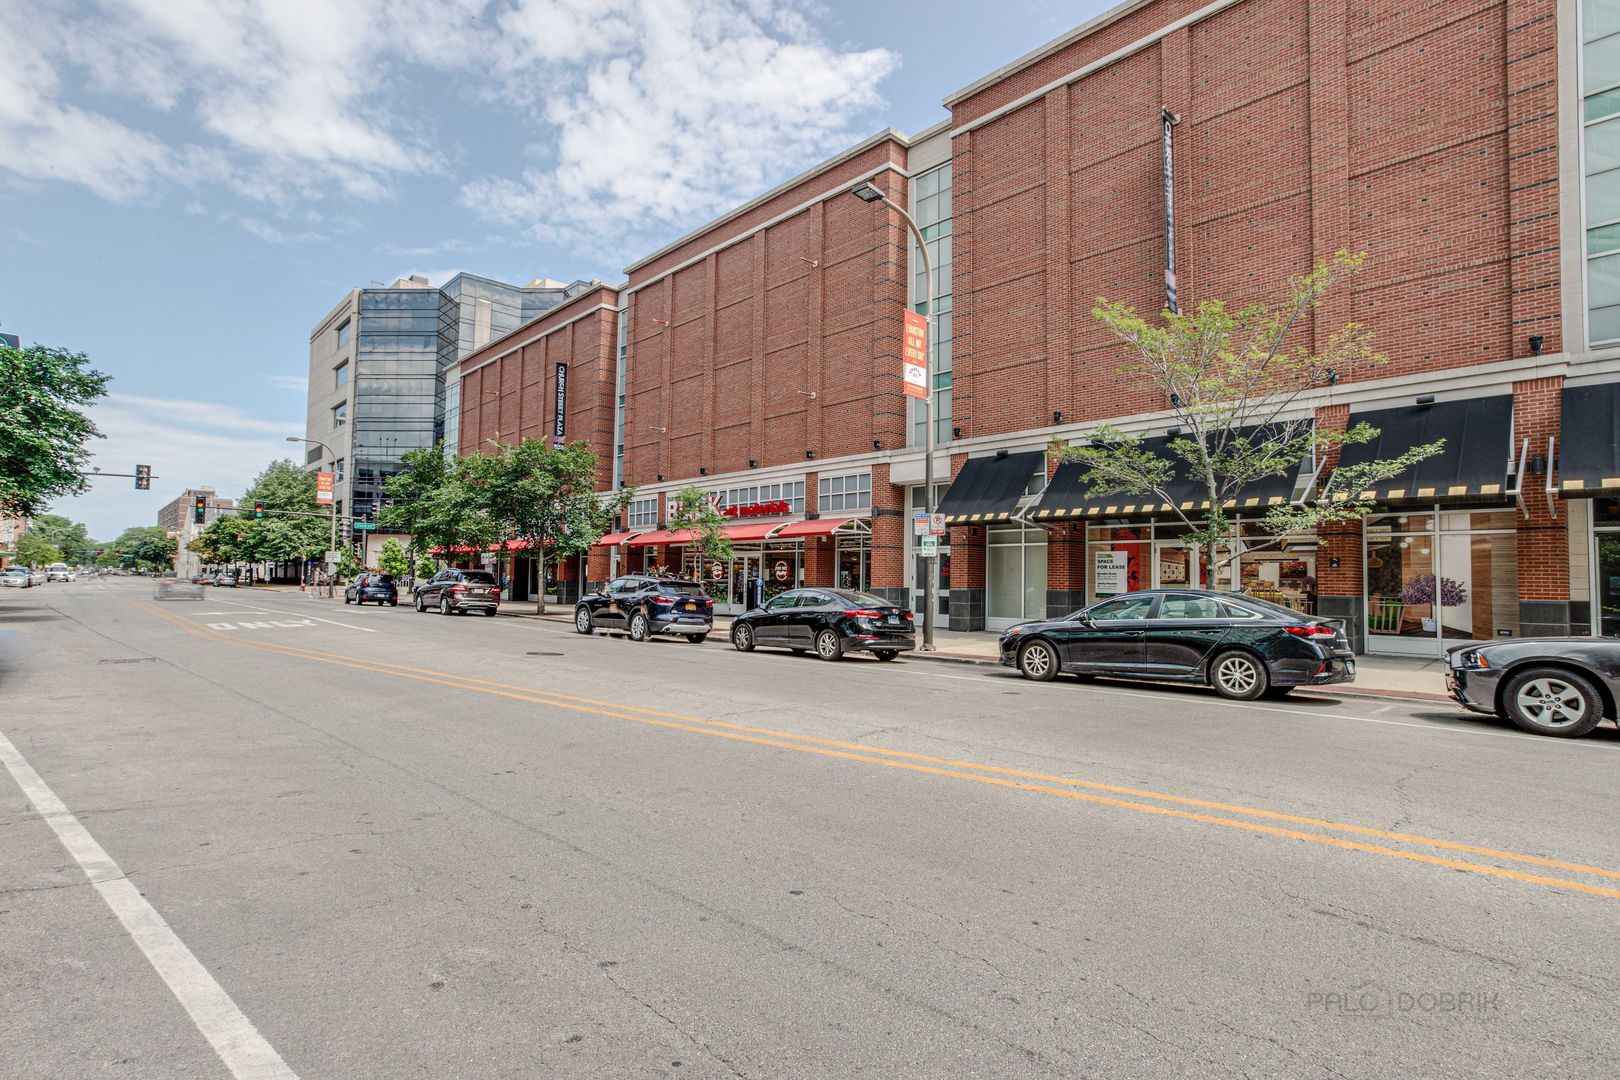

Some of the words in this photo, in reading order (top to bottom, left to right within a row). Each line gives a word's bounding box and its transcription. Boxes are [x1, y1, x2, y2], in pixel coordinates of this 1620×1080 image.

[1164, 121, 1172, 176] CHURCH
[556, 414, 564, 435] PLAZA
[722, 504, 738, 517] art
[739, 499, 792, 516] materials
[205, 619, 319, 630] ONLY
